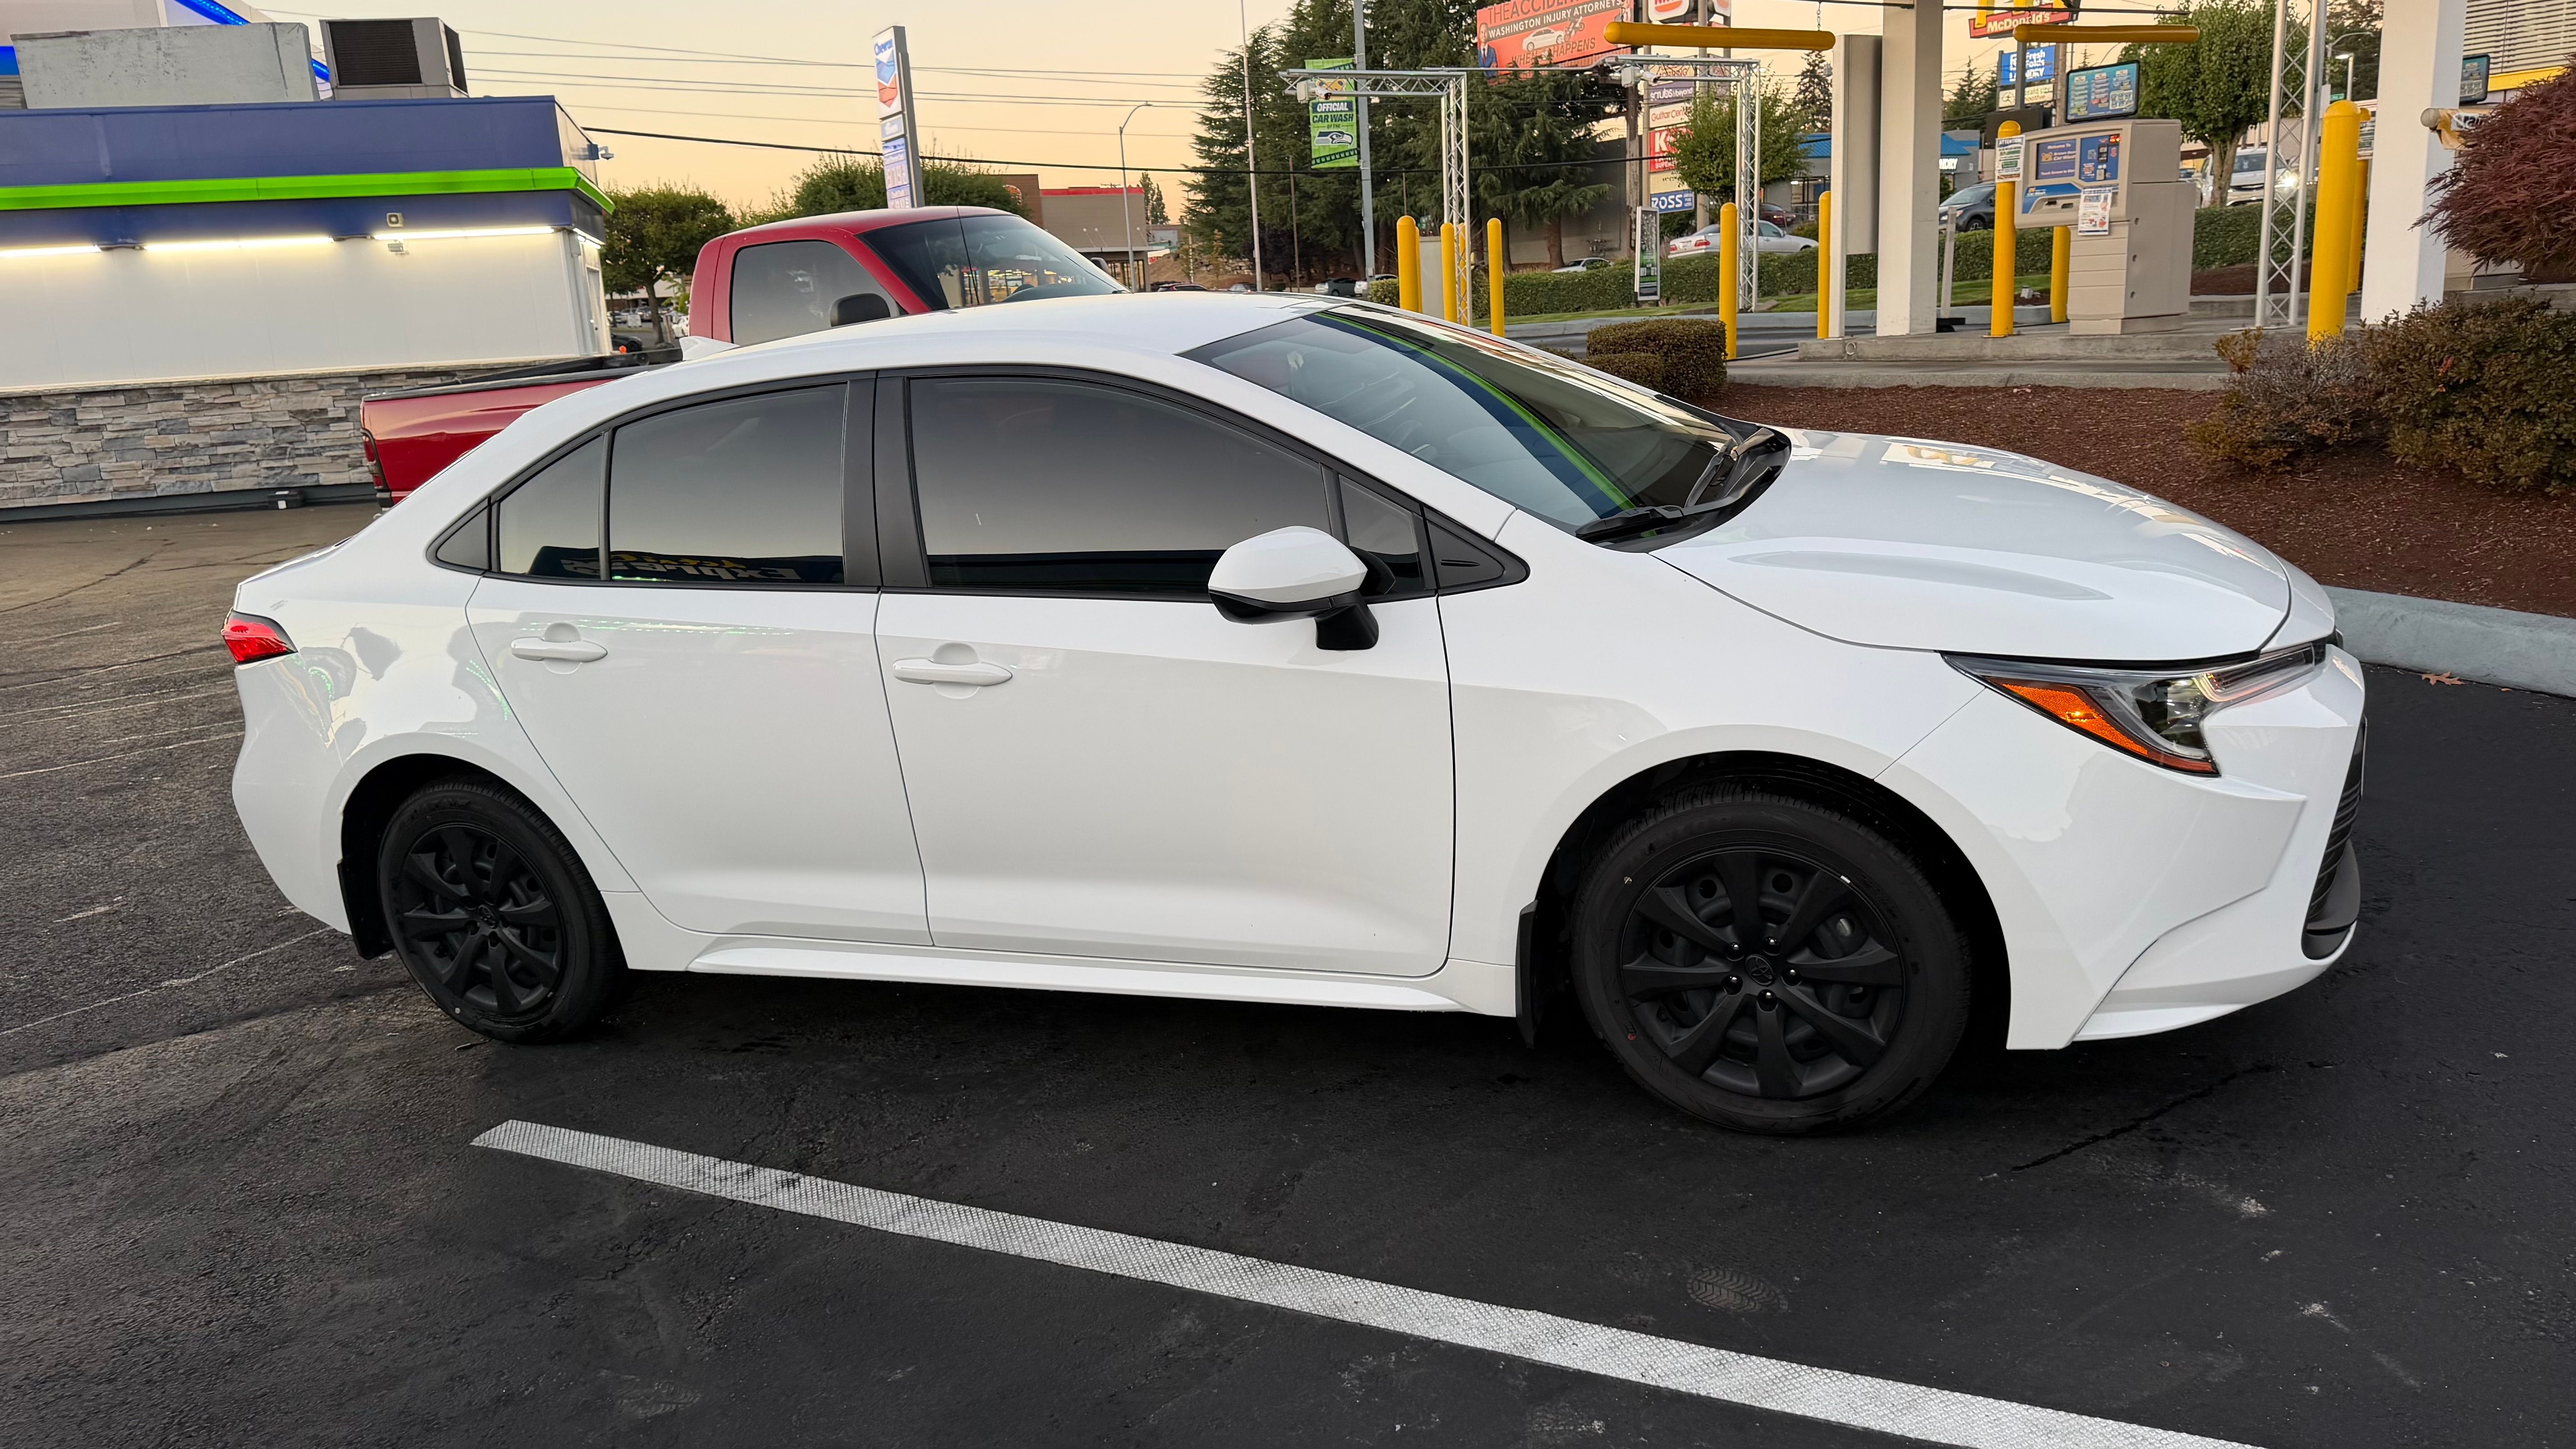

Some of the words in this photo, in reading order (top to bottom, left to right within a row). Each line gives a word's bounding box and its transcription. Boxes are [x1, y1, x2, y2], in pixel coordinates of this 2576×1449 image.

[1489, 17, 1541, 38] WASHINGTON
[1543, 9, 1571, 24] INJURY
[1573, 0, 1621, 16] ATTORNEYS
[1553, 37, 1596, 57] HAPPENS
[2026, 49, 2045, 60] Fresh
[1316, 102, 1348, 112] OFFICIAL
[1312, 114, 1329, 124] CAR
[1330, 113, 1353, 123] WASH
[1651, 110, 1670, 121] Guitar
[1939, 158, 1958, 170] NDRY
[1651, 194, 1683, 209] ROSS
